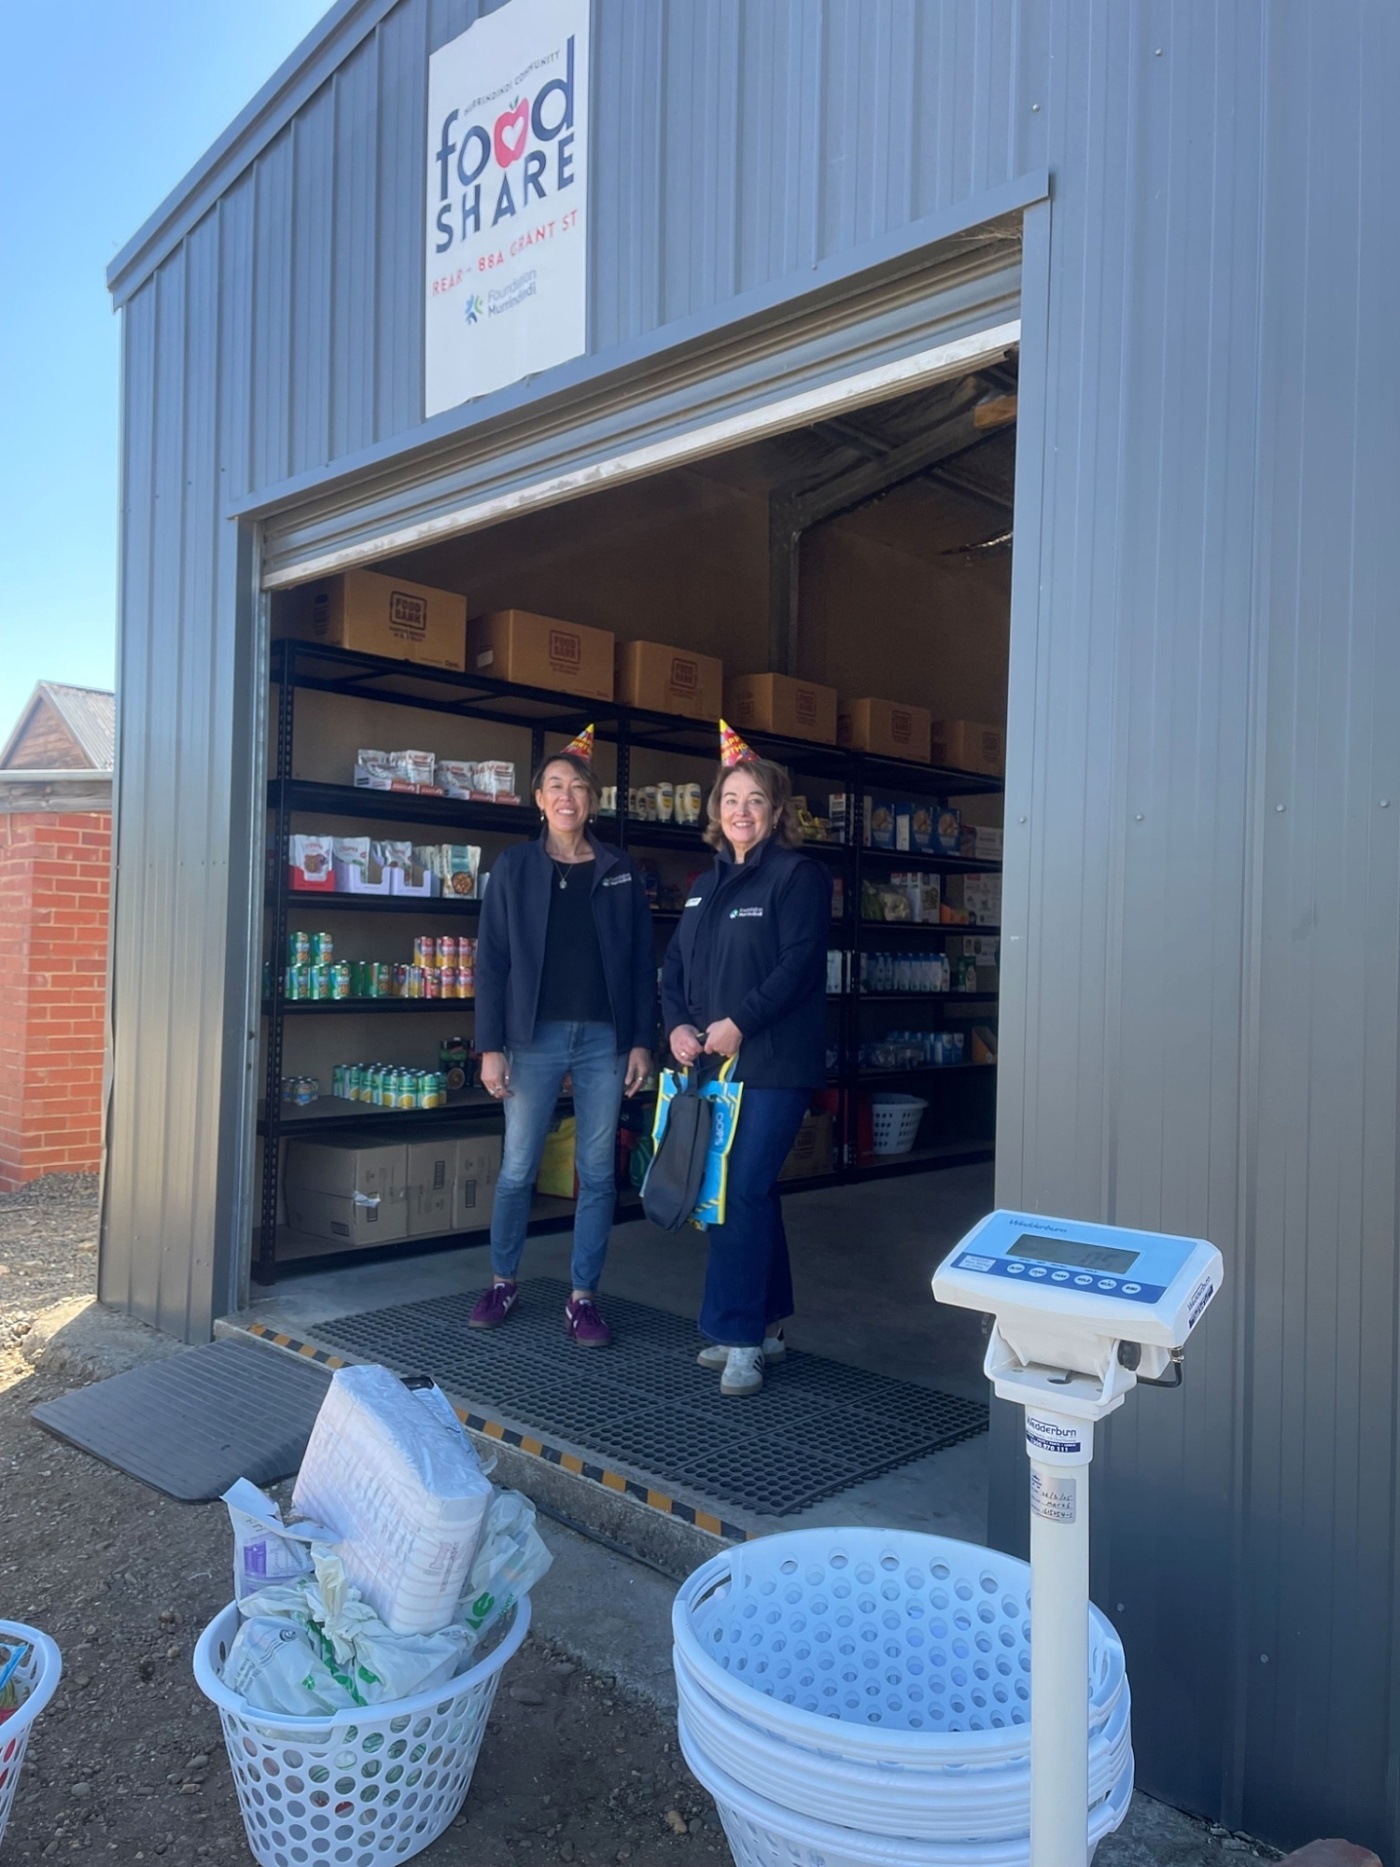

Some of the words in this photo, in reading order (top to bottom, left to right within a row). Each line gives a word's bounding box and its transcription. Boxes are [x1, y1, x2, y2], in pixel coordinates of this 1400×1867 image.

[514, 49, 561, 86] COMMUNITY
[436, 131, 575, 254] SHARE
[510, 221, 556, 257] GRANT
[561, 209, 578, 232] ST
[487, 269, 537, 303] Foundation
[395, 597, 422, 613] FOOD
[395, 608, 422, 624] BANK
